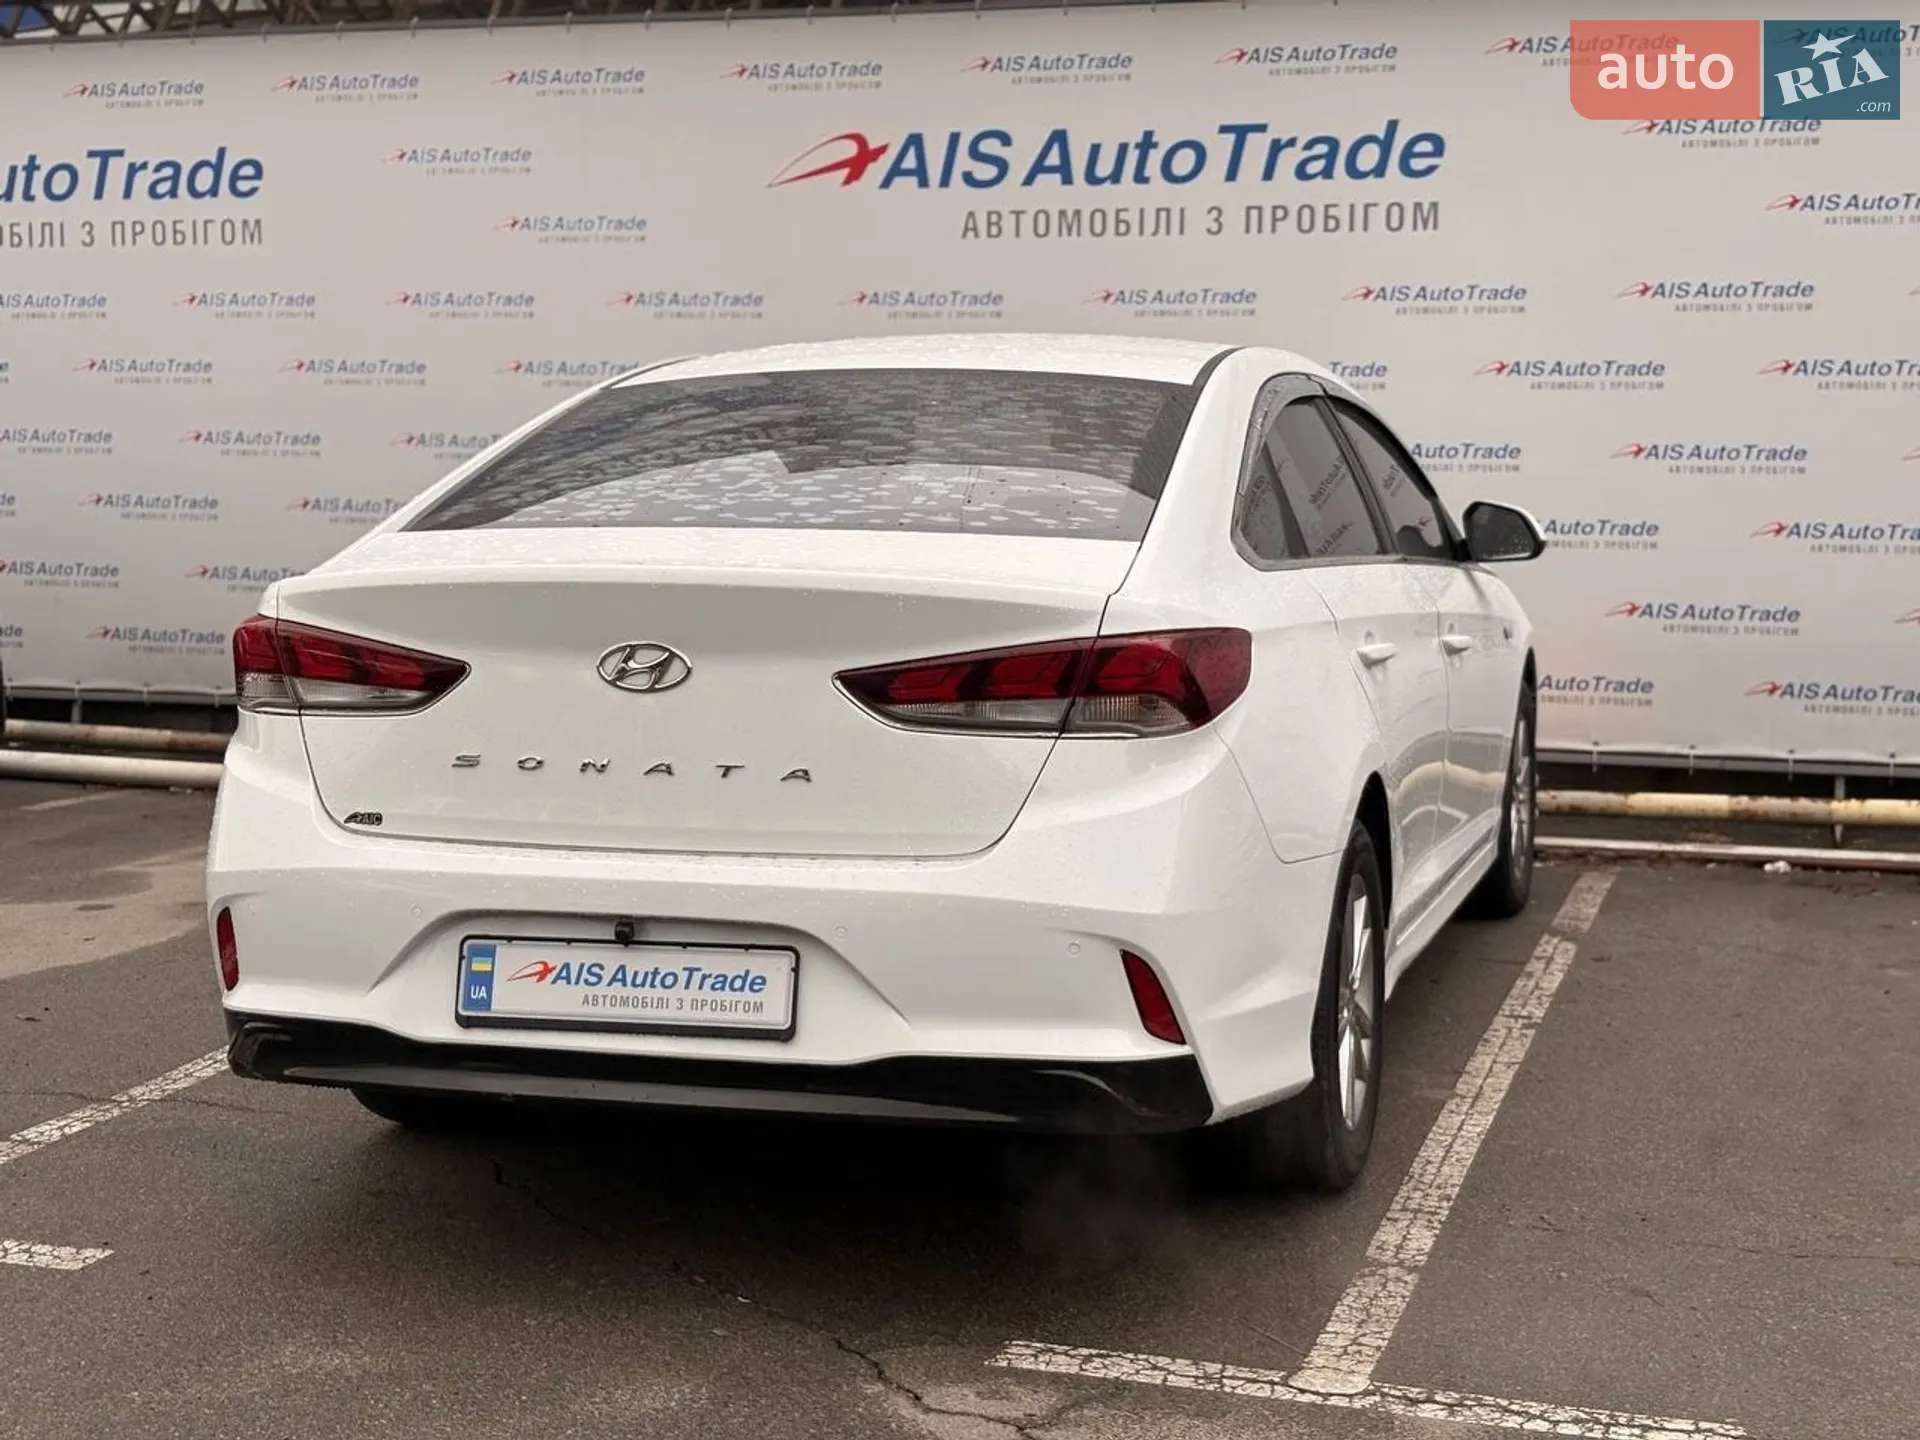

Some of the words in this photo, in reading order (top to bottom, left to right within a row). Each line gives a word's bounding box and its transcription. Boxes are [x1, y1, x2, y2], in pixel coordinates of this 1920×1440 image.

[1245, 46, 1284, 64] AIS
[1286, 43, 1397, 62] AutoTrade
[1518, 36, 1558, 53] AIS
[990, 56, 1025, 72] AIS
[1027, 52, 1133, 71] AutoTrade
[878, 128, 1013, 190] AIS
[1020, 119, 1446, 187] AutoTrade
[0, 147, 264, 202] utoTrade
[1800, 194, 1841, 211] AIS
[1844, 193, 1920, 210] AutoTr
[961, 207, 1186, 240] АВТОМОБІЛІ
[1206, 205, 1224, 236] З
[1244, 201, 1441, 235] ПРОБІГОМ
[0, 221, 65, 248] БІЛІ
[80, 220, 96, 248] З
[111, 218, 264, 248] ПРОБІГОМ
[1112, 289, 1148, 305] AIS
[1150, 288, 1257, 304] AutoTrade
[1373, 286, 1411, 301] AIS
[1413, 284, 1527, 301] AutoTrade
[1650, 282, 1691, 299] AIS
[1694, 281, 1814, 298] AutoTrade
[1507, 360, 1546, 376] AIS
[1548, 360, 1665, 376] AutoTrade
[1793, 360, 1834, 376] AIS
[1411, 443, 1521, 460] AutoTrade
[1643, 444, 1684, 460] AIS
[1687, 444, 1808, 461] AutoTrade
[1544, 520, 1659, 536] AutoTrade
[1785, 523, 1827, 539] AIS
[1829, 523, 1920, 540] AutoTra
[1639, 603, 1677, 619] AIS
[1681, 604, 1800, 623] AutoTrade
[1538, 675, 1654, 694] AutoTrade
[1779, 682, 1820, 700] AIS
[452, 753, 813, 783] SONATA
[550, 961, 604, 988] AIS
[606, 963, 768, 994] AutoTrade
[470, 985, 488, 1000] UA
[582, 993, 669, 1010] АВТОМОБІЛІ
[677, 997, 684, 1011] З
[690, 998, 764, 1014] ПРОБІГОМ
